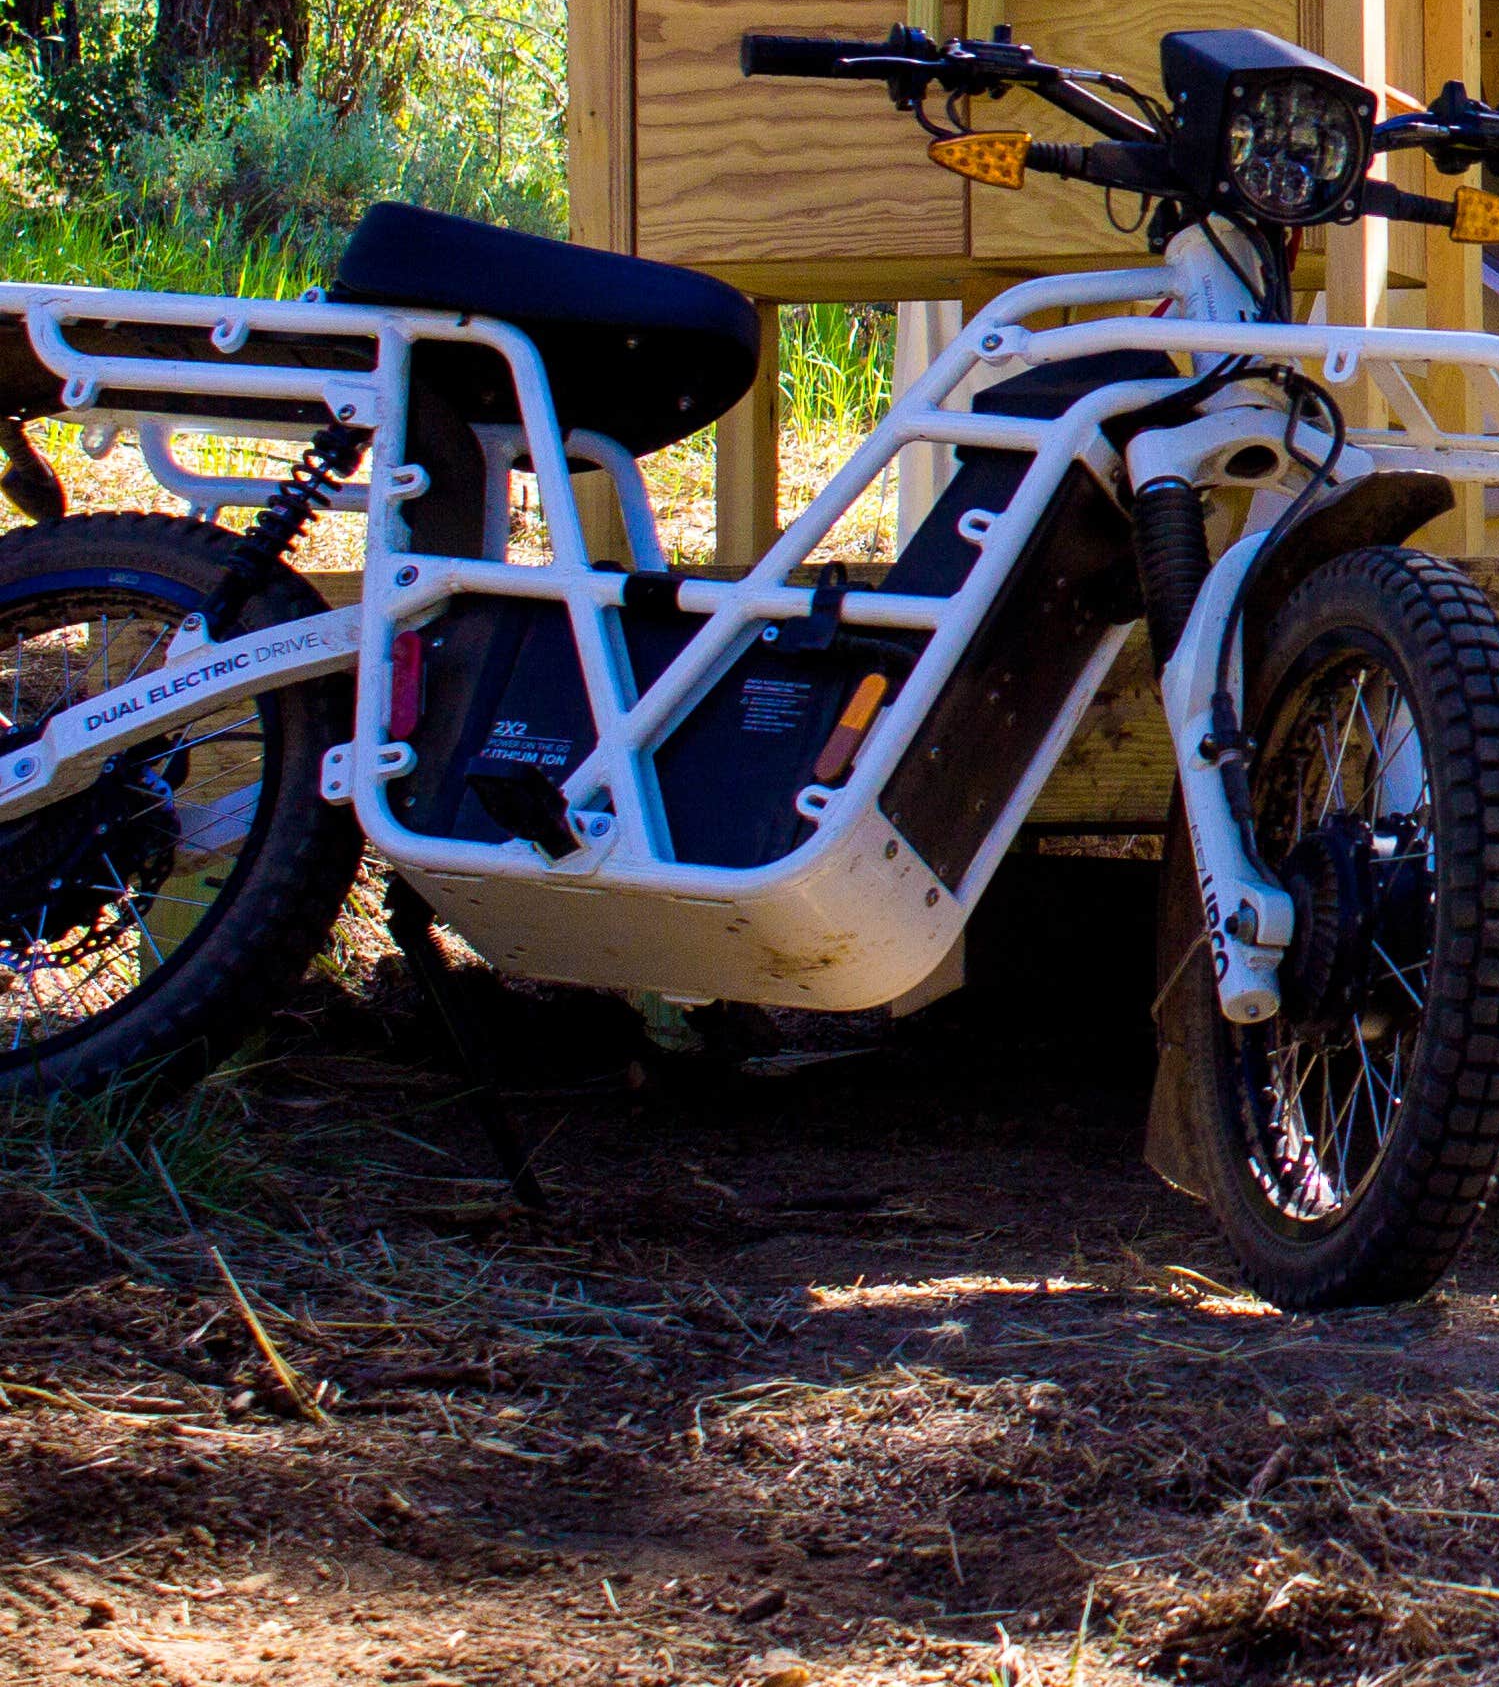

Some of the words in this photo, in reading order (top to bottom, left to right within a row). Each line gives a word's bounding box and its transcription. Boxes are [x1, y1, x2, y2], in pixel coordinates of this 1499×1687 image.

[86, 698, 144, 731] DUAL
[148, 653, 250, 705] ELECTRIC
[255, 631, 320, 663] DRIVE
[540, 754, 568, 766] ION
